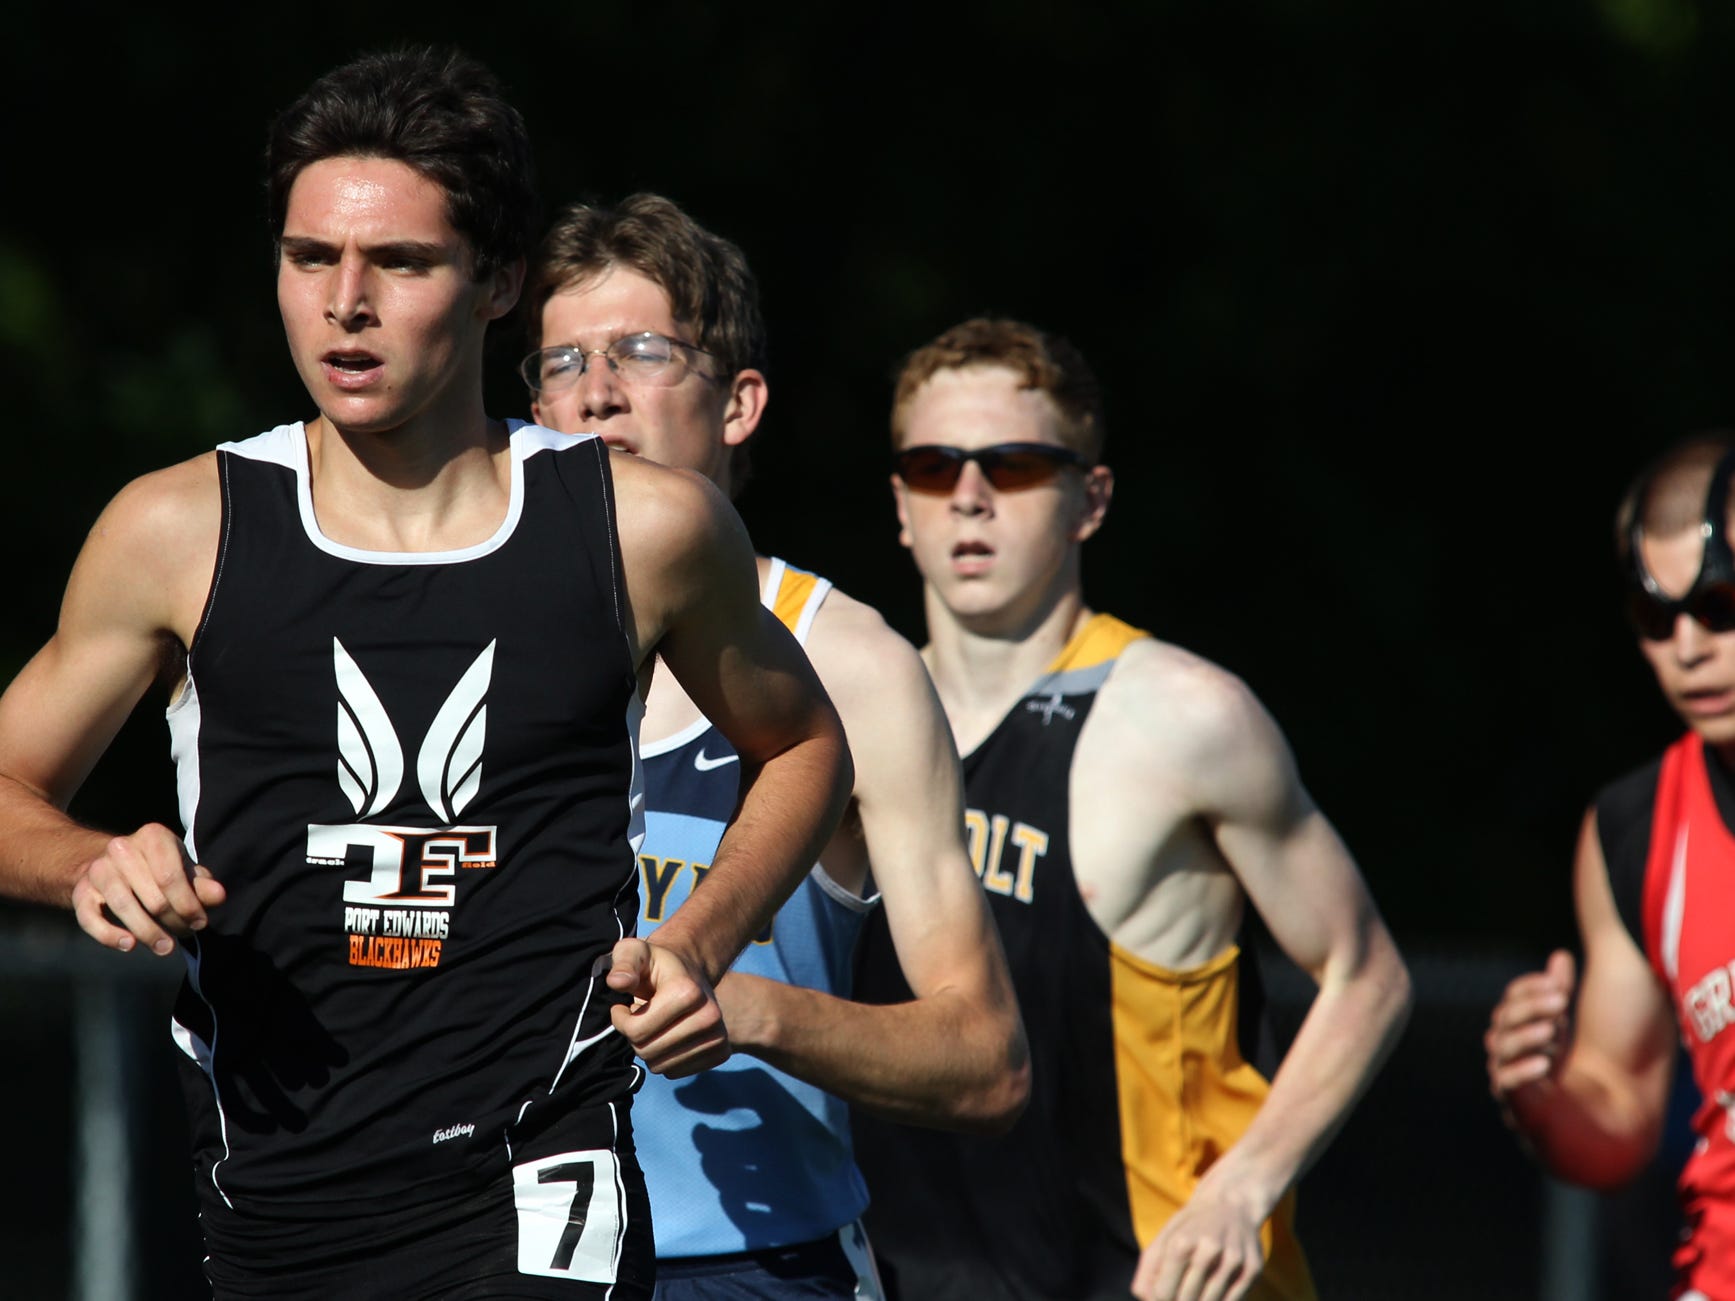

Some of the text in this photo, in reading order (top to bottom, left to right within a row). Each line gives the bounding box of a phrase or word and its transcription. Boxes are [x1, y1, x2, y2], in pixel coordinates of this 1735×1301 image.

[344, 907, 450, 939] PORT EDWARDS
[349, 935, 442, 970] BLACKHAWKS
[432, 1123, 475, 1144] Eastbay
[537, 1161, 594, 1271] 7
